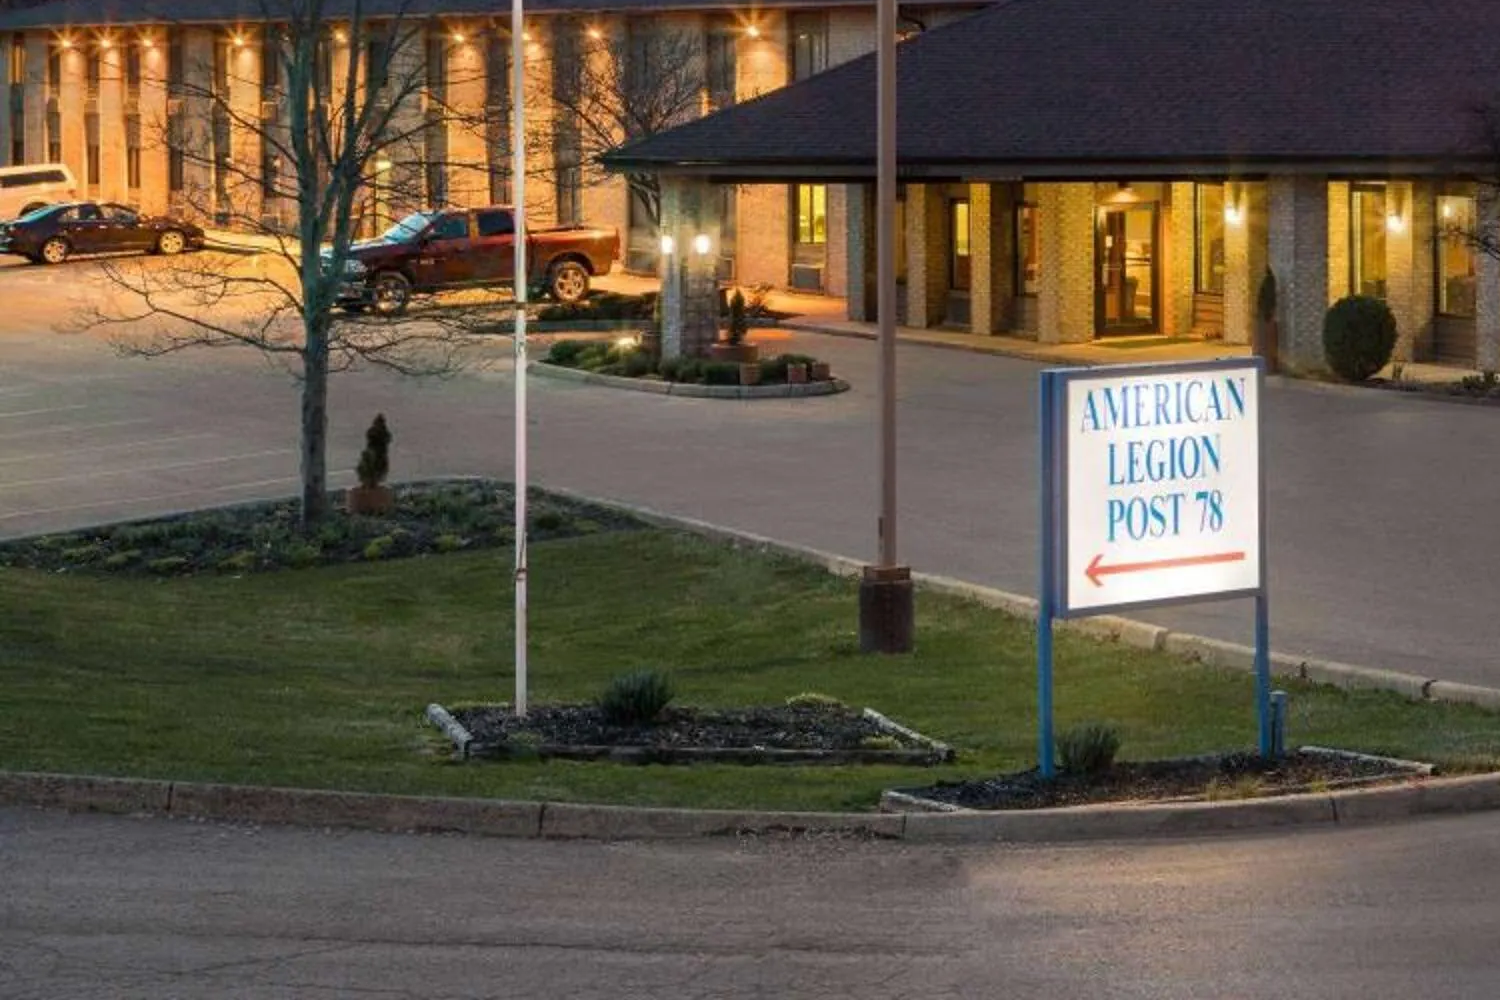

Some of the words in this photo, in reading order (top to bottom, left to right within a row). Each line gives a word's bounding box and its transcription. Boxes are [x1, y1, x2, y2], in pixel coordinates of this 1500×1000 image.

[1081, 376, 1246, 433] AMERICAN
[1108, 433, 1222, 486] LEGION
[1106, 492, 1186, 543] POST
[1195, 489, 1224, 534] 78
